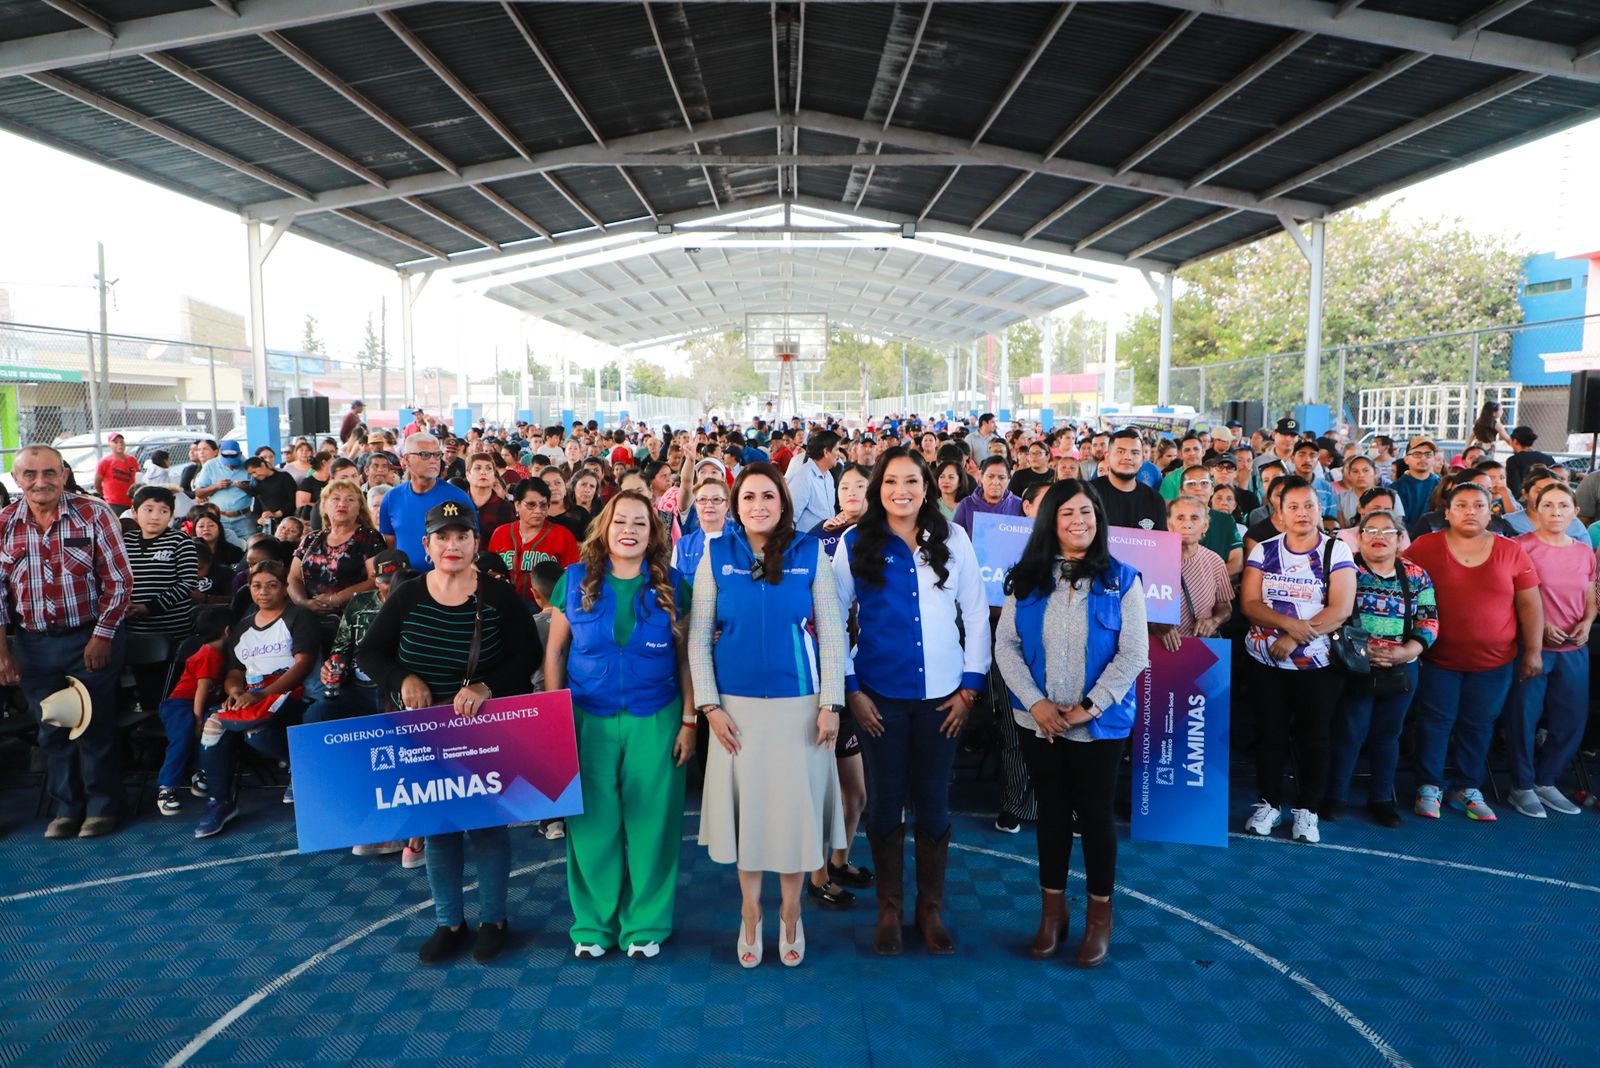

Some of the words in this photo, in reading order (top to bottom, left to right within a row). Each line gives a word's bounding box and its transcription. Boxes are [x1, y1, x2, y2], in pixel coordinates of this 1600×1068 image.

[999, 523, 1034, 535] GOBIERN
[1107, 535, 1157, 547] ASCALIENTES
[1264, 573, 1322, 586] CARRERA
[323, 728, 385, 745] GOBIERNO
[395, 721, 438, 735] ESTADO
[447, 707, 539, 728] AGUASCALIENTES
[1182, 694, 1206, 787] LÁMINAS
[399, 746, 432, 758] gigante
[443, 748, 479, 759] Desarrollo
[479, 745, 500, 755] Social
[1142, 733, 1150, 764] ESTADO
[405, 753, 435, 764] México
[375, 771, 502, 810] LÁMINAS
[1141, 771, 1150, 816] GOBIERNO
